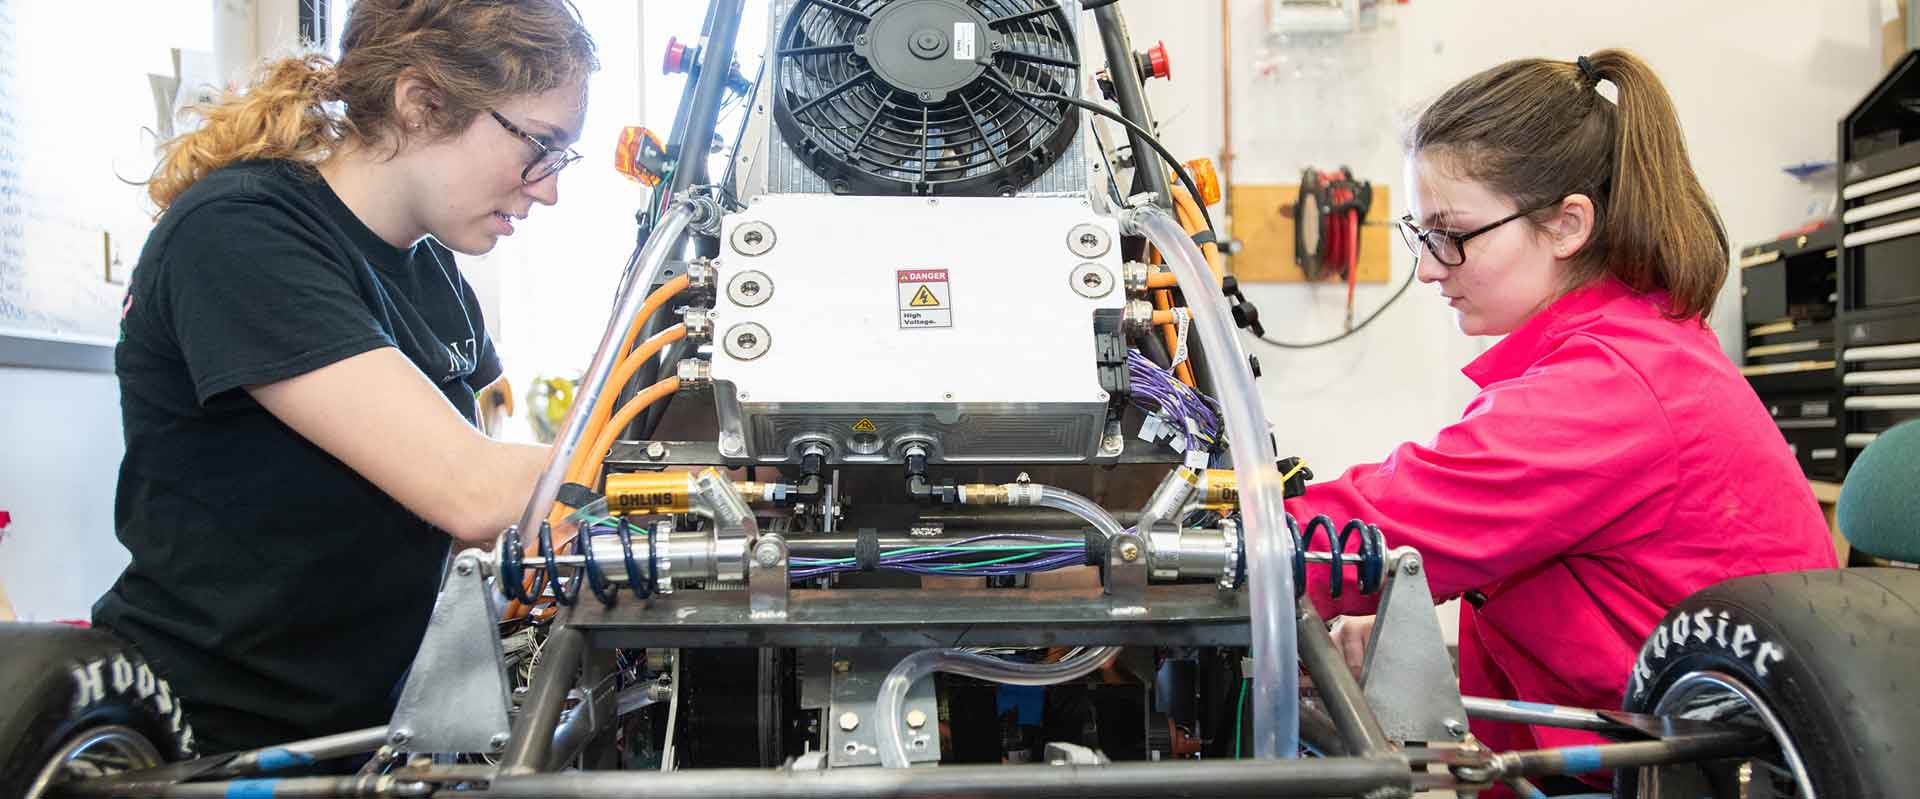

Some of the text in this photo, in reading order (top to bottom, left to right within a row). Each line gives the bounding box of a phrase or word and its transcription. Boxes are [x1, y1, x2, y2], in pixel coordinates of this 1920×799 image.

[910, 272, 946, 280] DANGER
[1632, 607, 1785, 700] Hoosier
[71, 652, 201, 760] Hoosie
